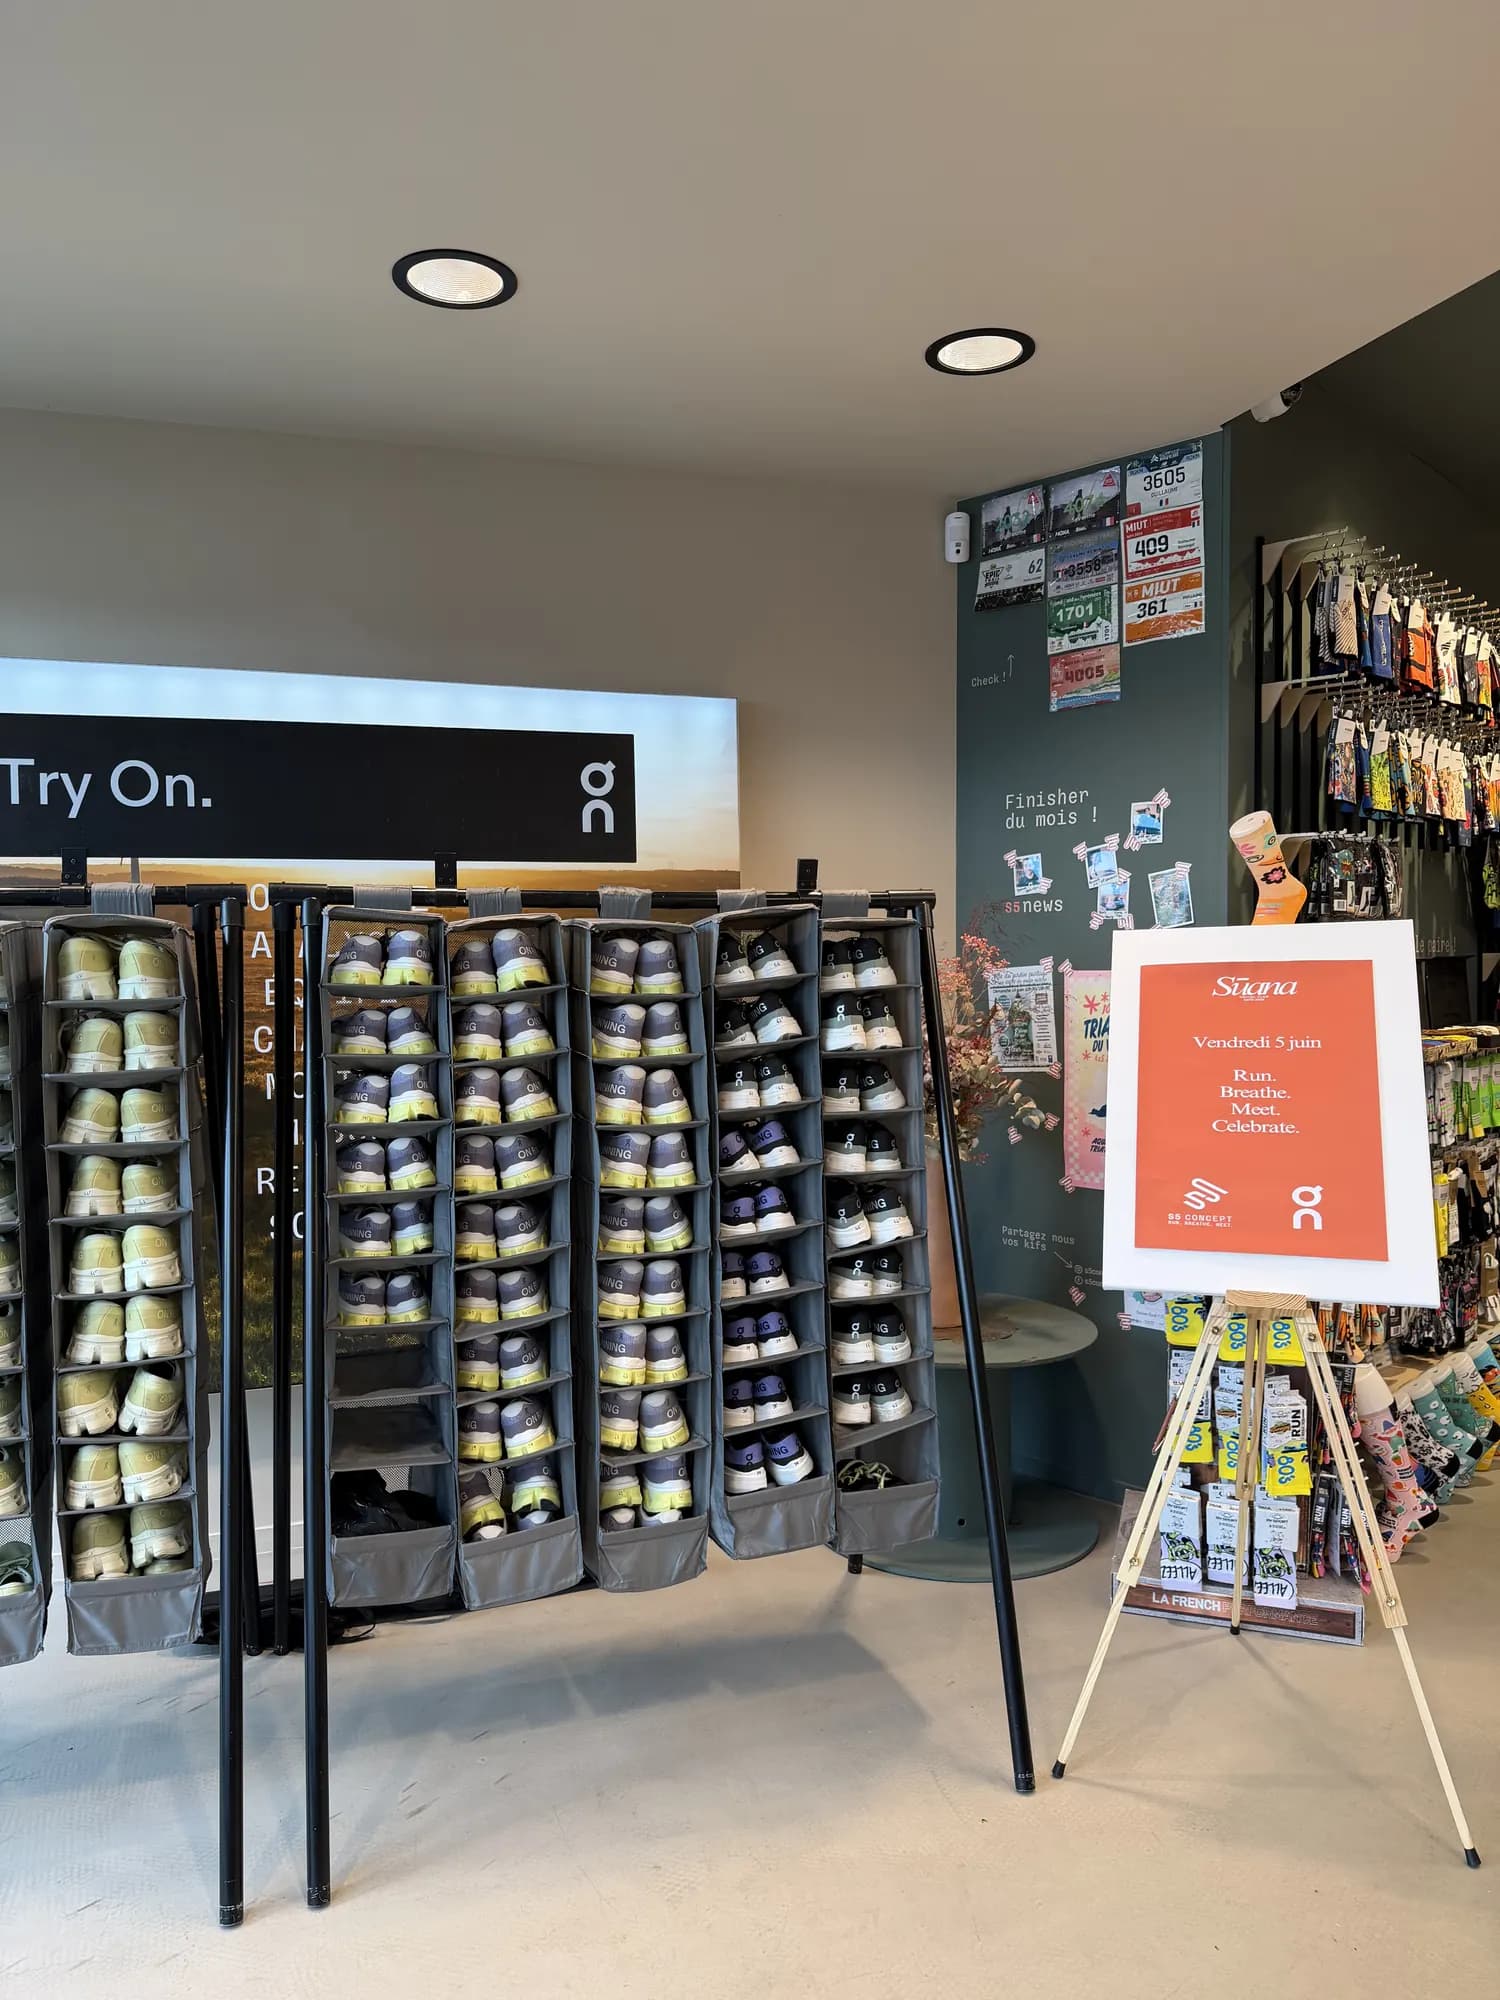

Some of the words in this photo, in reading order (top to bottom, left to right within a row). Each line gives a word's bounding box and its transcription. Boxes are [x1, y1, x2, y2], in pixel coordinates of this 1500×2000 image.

[1143, 466, 1186, 491] 3605
[1125, 519, 1148, 534] MIUT
[1135, 534, 1169, 557] 409
[1029, 558, 1043, 574] 62
[1068, 558, 1101, 577] 3558
[1142, 578, 1180, 599] MIUT
[1056, 601, 1093, 622] 1701
[1136, 597, 1168, 619] 361
[971, 672, 1000, 688] Check
[1065, 664, 1105, 683] 4005
[0, 757, 92, 819] Try
[110, 758, 213, 808] On.
[1005, 788, 1089, 810] Finisher
[1005, 812, 1025, 829] du
[1035, 809, 1078, 828] mois
[1193, 1035, 1271, 1049] Vendredi
[1275, 1037, 1285, 1049] 5
[1286, 1036, 1322, 1051] juin
[1232, 1068, 1276, 1082] Run.
[1220, 1085, 1291, 1099] Breathe.
[1231, 1103, 1280, 1116] Meet.
[1212, 1120, 1300, 1134] Celebrate.
[1184, 1214, 1233, 1222] CONCEPT
[1002, 1226, 1046, 1241] Partagez
[1052, 1234, 1075, 1245] nous
[1002, 1238, 1018, 1247] vos
[1024, 1240, 1046, 1251] kifs
[1292, 1409, 1301, 1437] RUN
[1314, 1505, 1323, 1522] RUN
[1342, 1507, 1350, 1525] RUN
[1152, 1591, 1169, 1605] LA
[1172, 1595, 1221, 1612] FRENCH
